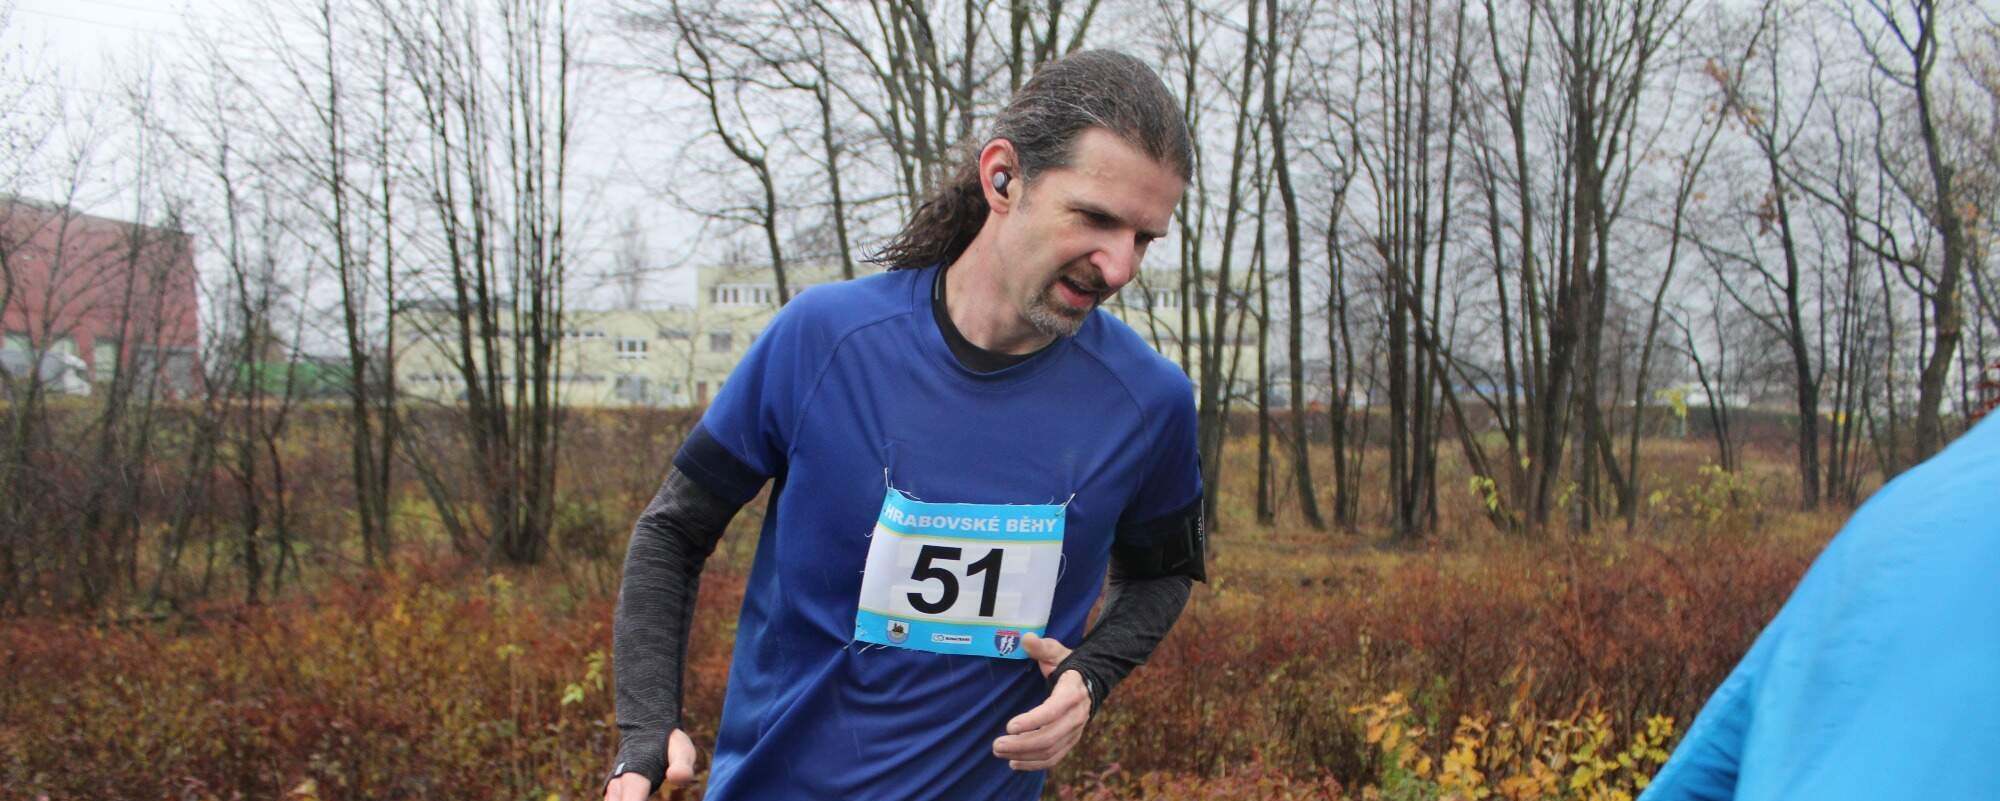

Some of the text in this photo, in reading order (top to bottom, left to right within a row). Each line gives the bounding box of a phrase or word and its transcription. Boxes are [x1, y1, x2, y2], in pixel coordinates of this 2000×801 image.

[884, 503, 1057, 533] HRABOVSKÉ BĚHY
[906, 544, 1005, 618] 51
